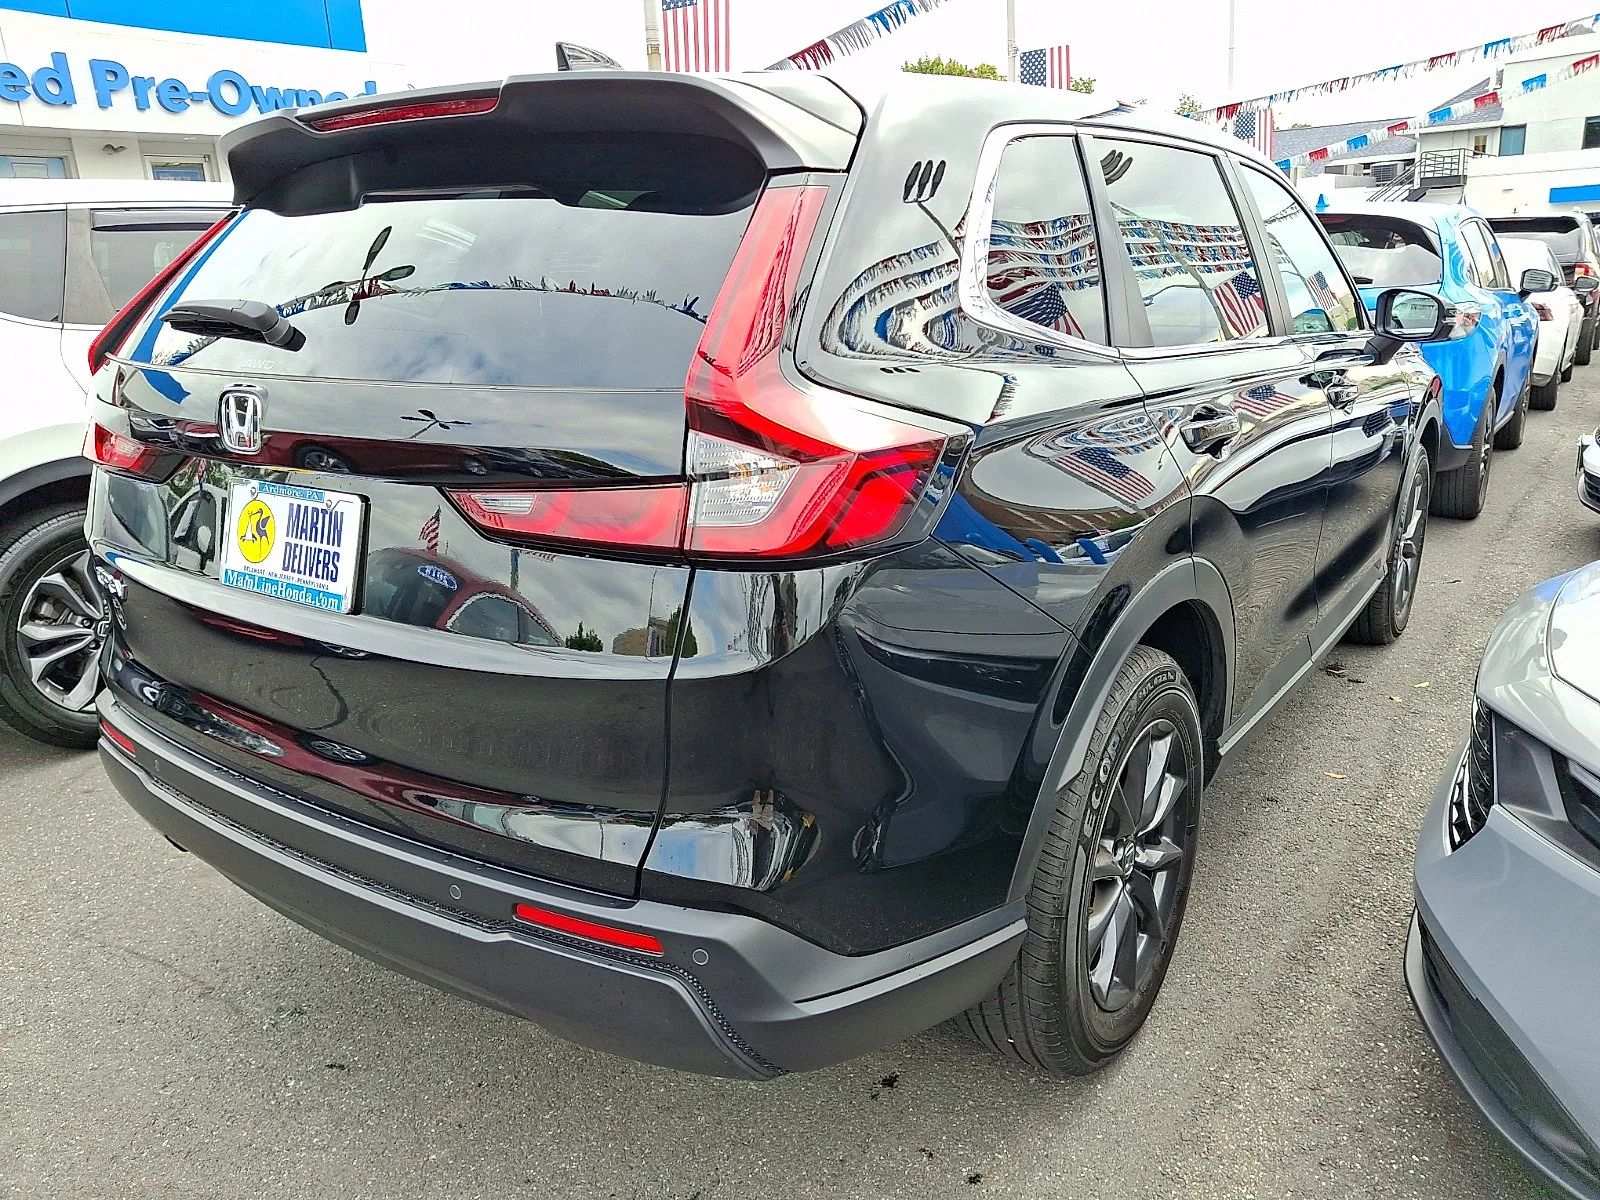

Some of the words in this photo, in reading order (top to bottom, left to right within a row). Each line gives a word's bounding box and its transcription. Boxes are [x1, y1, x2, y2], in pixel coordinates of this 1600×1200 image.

[263, 483, 303, 497] Ardmore,
[306, 490, 319, 500] PA
[286, 503, 344, 547] MARTIN
[282, 541, 340, 583] DELIVERS
[226, 569, 339, 610] MainLineHonda.com
